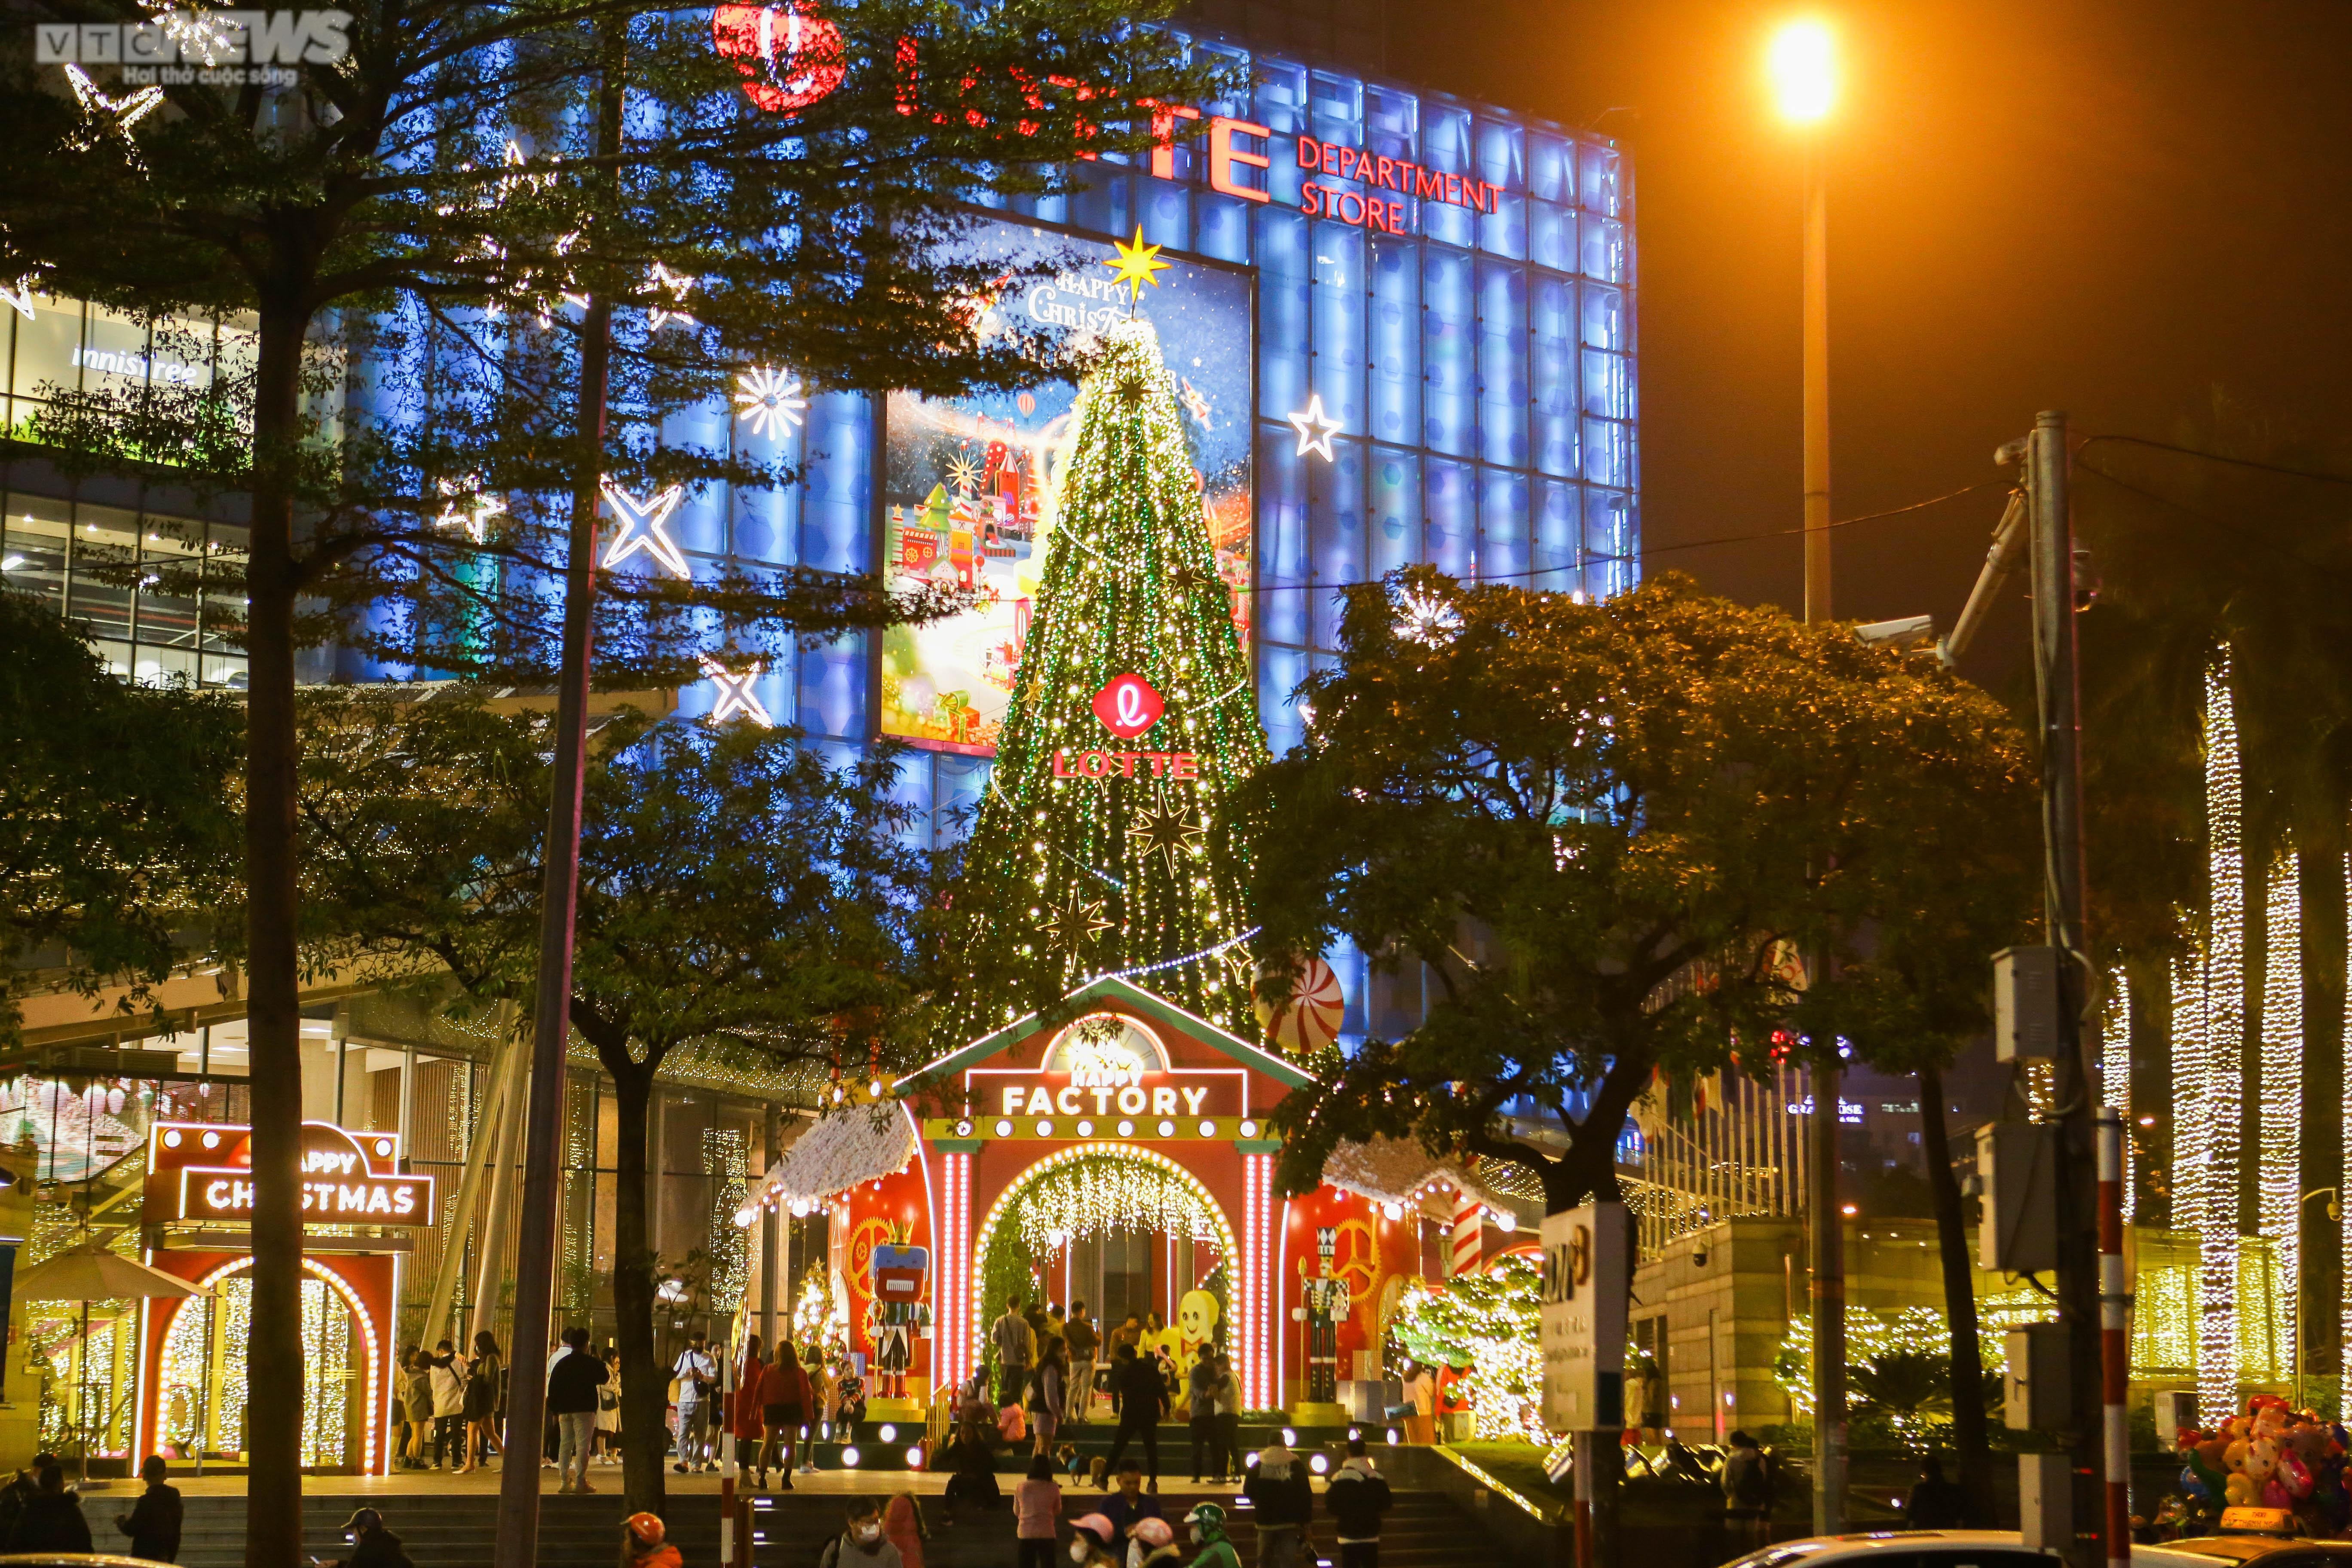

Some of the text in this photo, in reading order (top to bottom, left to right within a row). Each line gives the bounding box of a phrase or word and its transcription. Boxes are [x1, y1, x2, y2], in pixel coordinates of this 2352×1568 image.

[1298, 136, 1506, 214] DEPARTMENT
[1301, 182, 1406, 236] STORE
[1055, 271, 1130, 305] HAPPY
[1053, 751, 1199, 780] LOTTE
[1070, 1069, 1143, 1087] HAPPY
[1003, 1087, 1208, 1116] FACTORY
[206, 1180, 414, 1214] CHSTMAS
